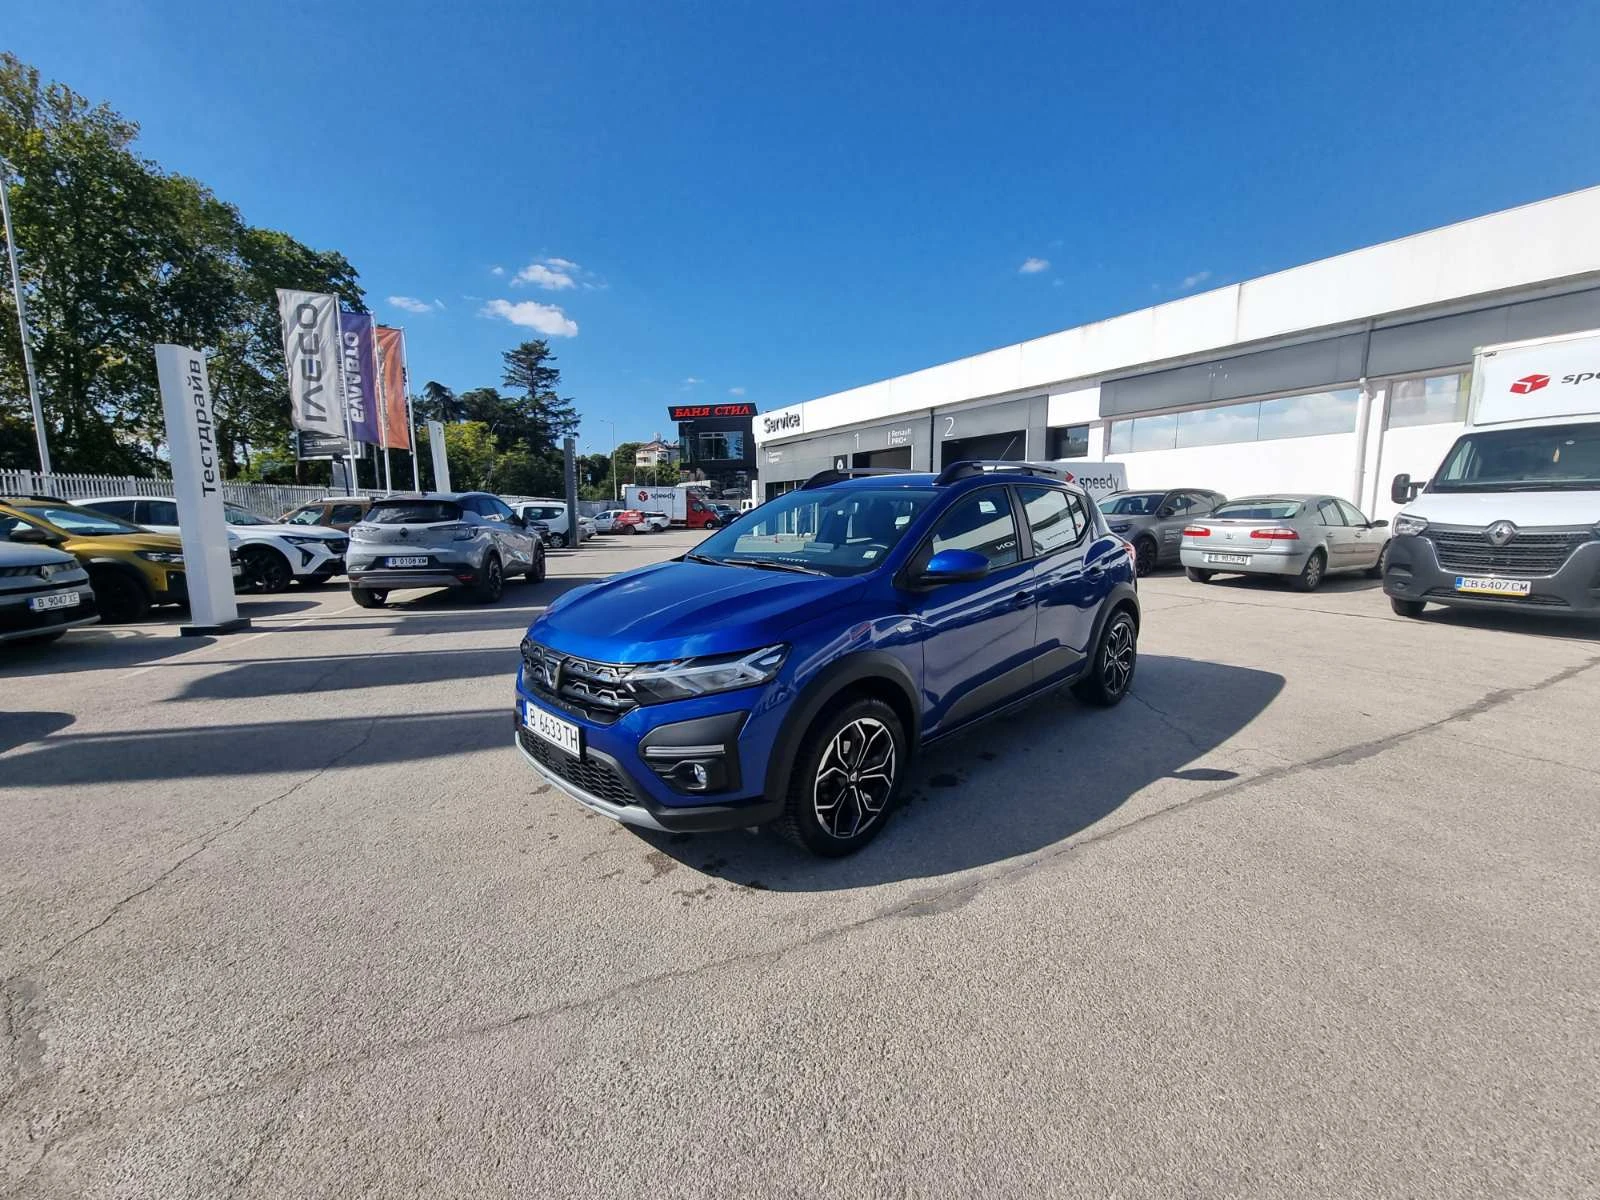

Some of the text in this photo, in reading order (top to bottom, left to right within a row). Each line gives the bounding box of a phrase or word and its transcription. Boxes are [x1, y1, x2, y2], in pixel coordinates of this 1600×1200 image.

[675, 405, 751, 417] БАНЯ СТИЛ
[187, 359, 216, 498] Тестдрайв
[763, 411, 801, 433] Service
[944, 416, 955, 437] 2
[854, 431, 861, 449] 1
[1079, 473, 1120, 491] speedy
[651, 492, 676, 500] speedy
[1480, 581, 1510, 591] 6407
[1511, 582, 1528, 592] CM
[539, 713, 562, 741] 6633
[562, 725, 578, 751] TH
